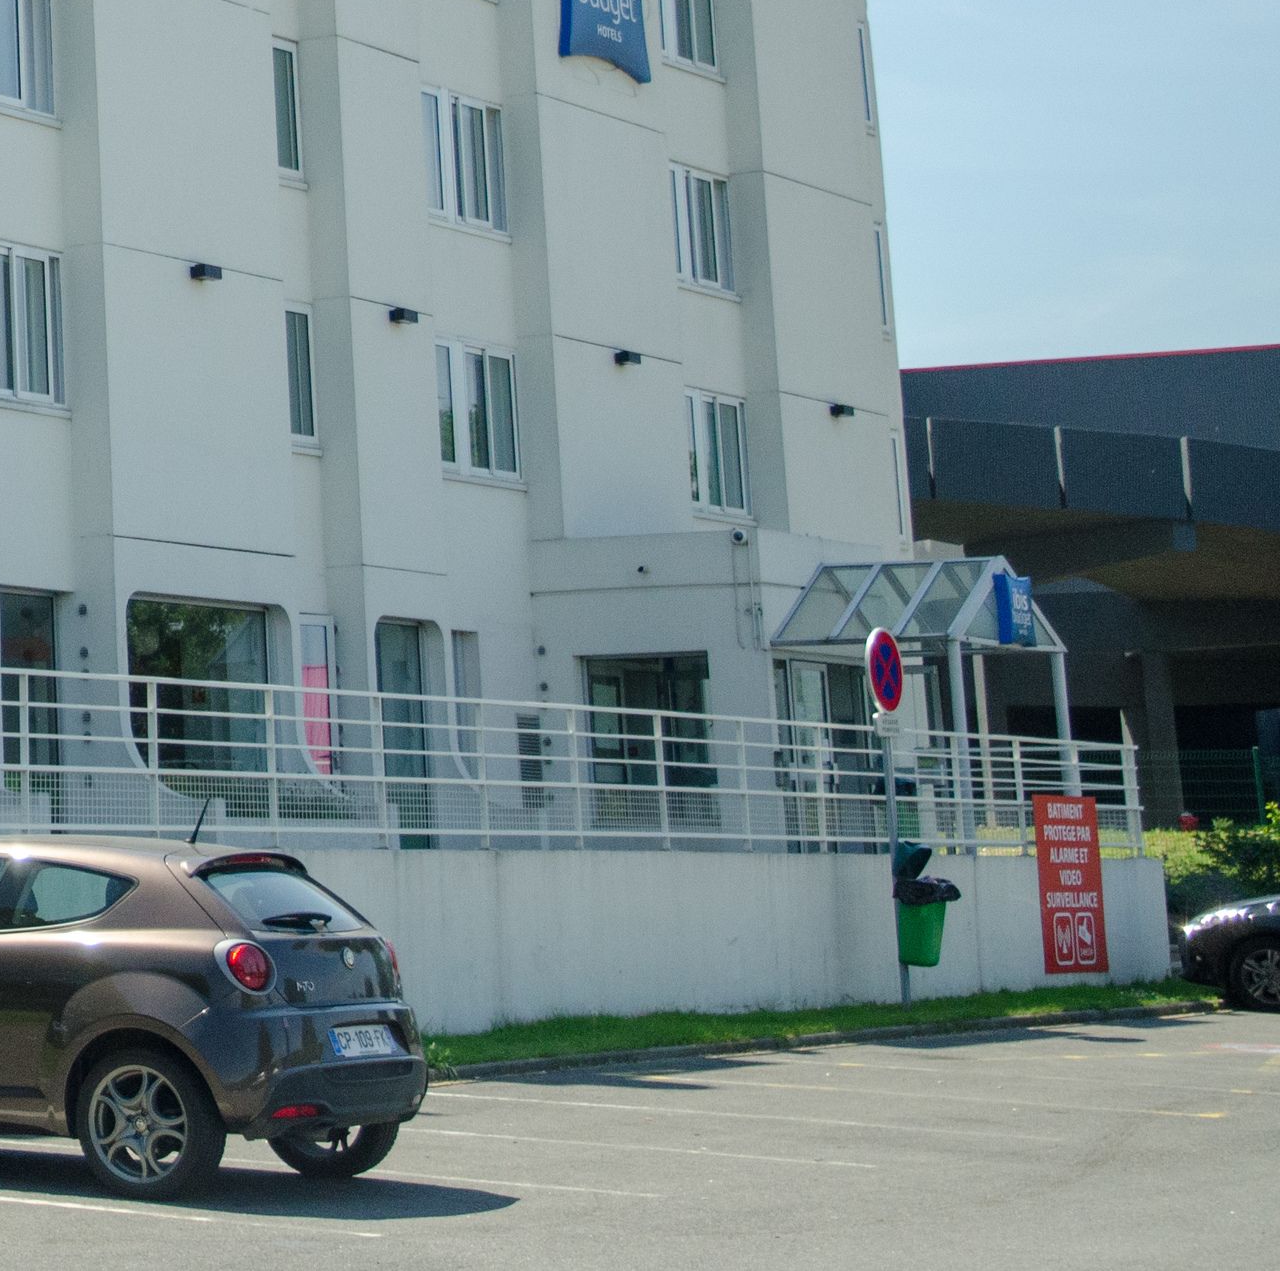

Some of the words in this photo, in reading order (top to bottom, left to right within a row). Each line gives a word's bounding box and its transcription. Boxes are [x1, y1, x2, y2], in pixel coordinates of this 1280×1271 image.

[597, 24, 623, 43] HOTELS
[1047, 803, 1084, 819] BATIMENT
[1076, 826, 1091, 841] PAR
[1050, 847, 1079, 864] ALARME
[1079, 848, 1089, 863] ET
[1059, 870, 1082, 886] VIDEO
[1046, 892, 1099, 908] SURVEILLANCE
